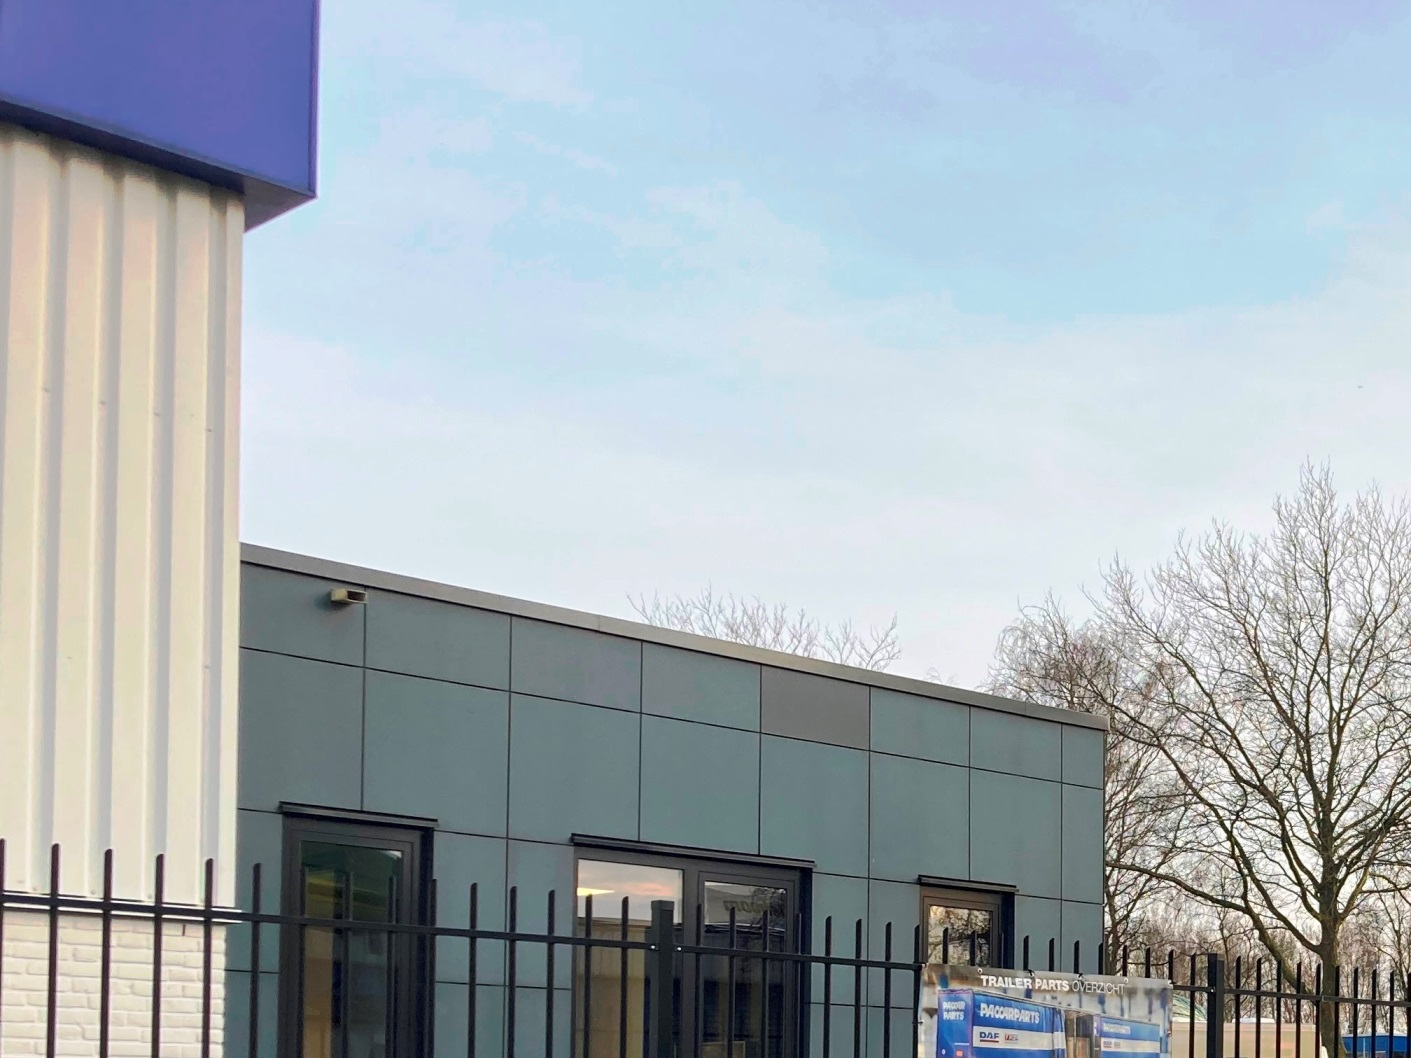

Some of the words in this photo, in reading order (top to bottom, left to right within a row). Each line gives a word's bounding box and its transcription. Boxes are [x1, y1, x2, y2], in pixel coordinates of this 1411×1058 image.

[980, 975, 1033, 989] TRAILER
[1035, 978, 1070, 992] PARTS
[1072, 980, 1126, 995] OVERZICHT
[943, 1010, 965, 1021] PARTS
[979, 1031, 1000, 1040] DAF
